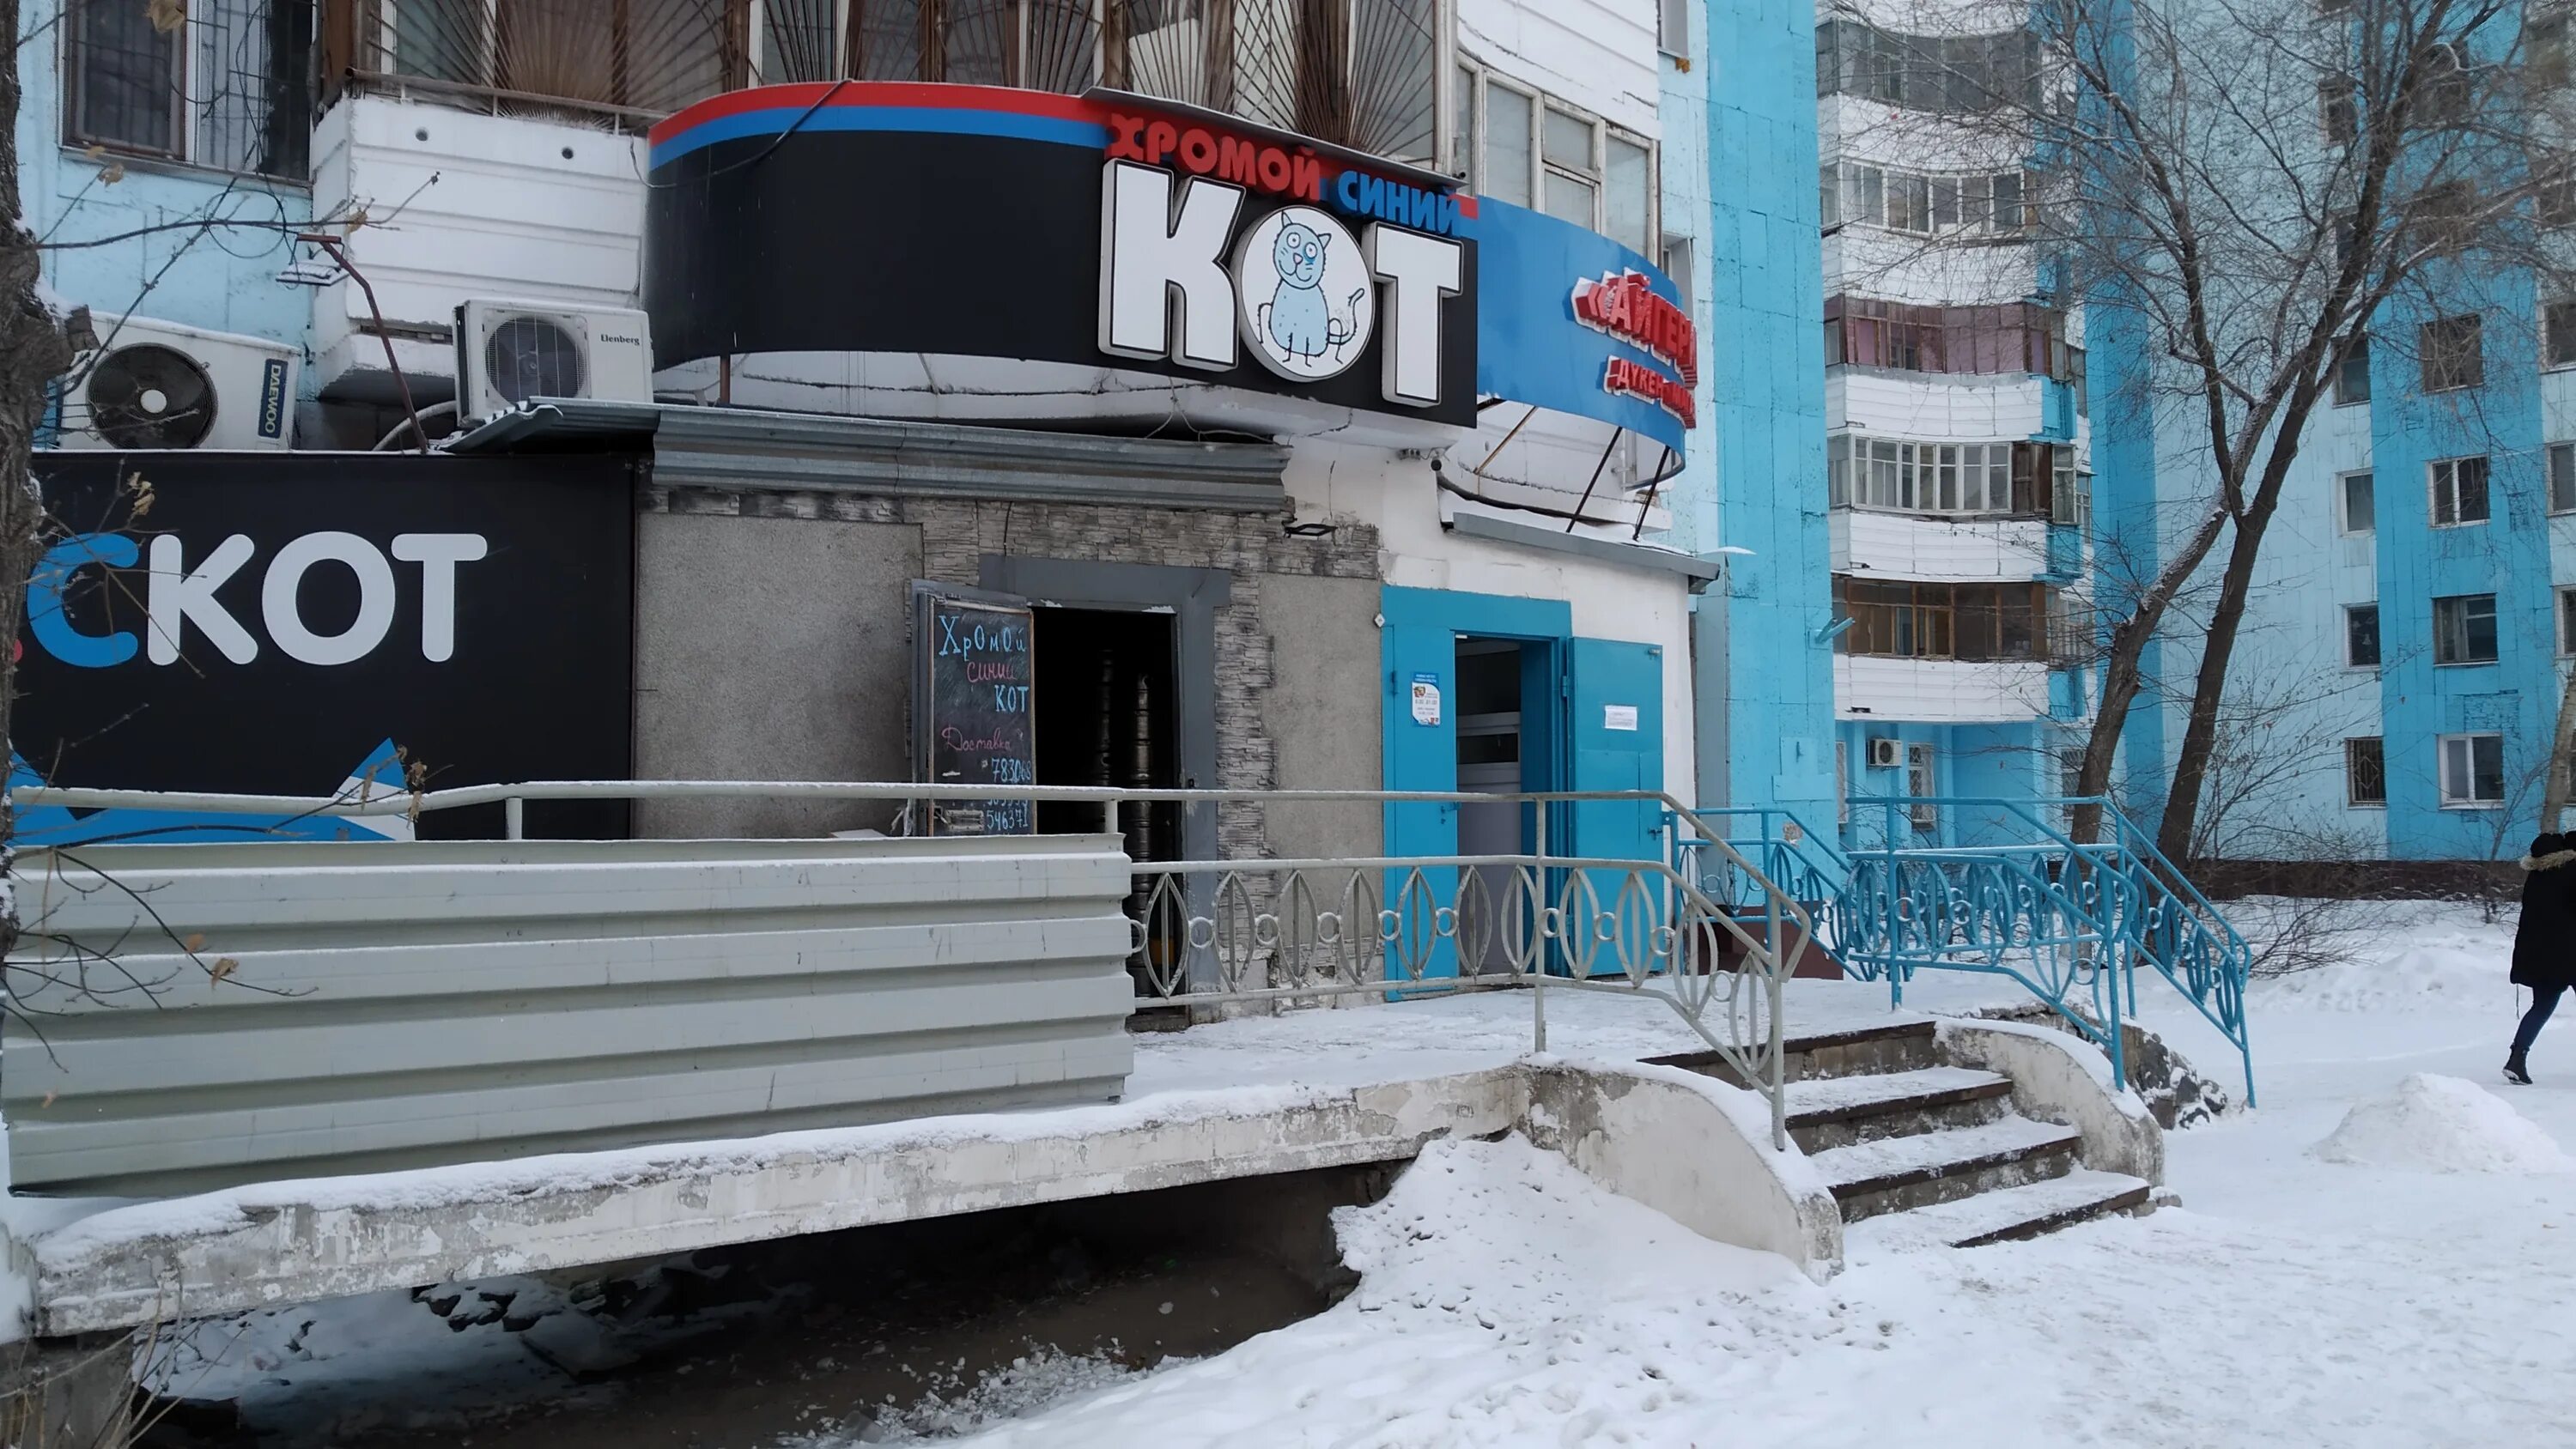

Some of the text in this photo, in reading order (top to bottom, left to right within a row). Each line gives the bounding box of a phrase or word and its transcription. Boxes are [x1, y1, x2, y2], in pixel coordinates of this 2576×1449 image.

[1107, 112, 1460, 236] ХРОМОЙ СИНИЙ
[1099, 158, 1463, 407] КОТ
[264, 364, 282, 433] DAEWOO
[941, 726, 1012, 752] Доставка
[987, 808, 1029, 831] 546371
